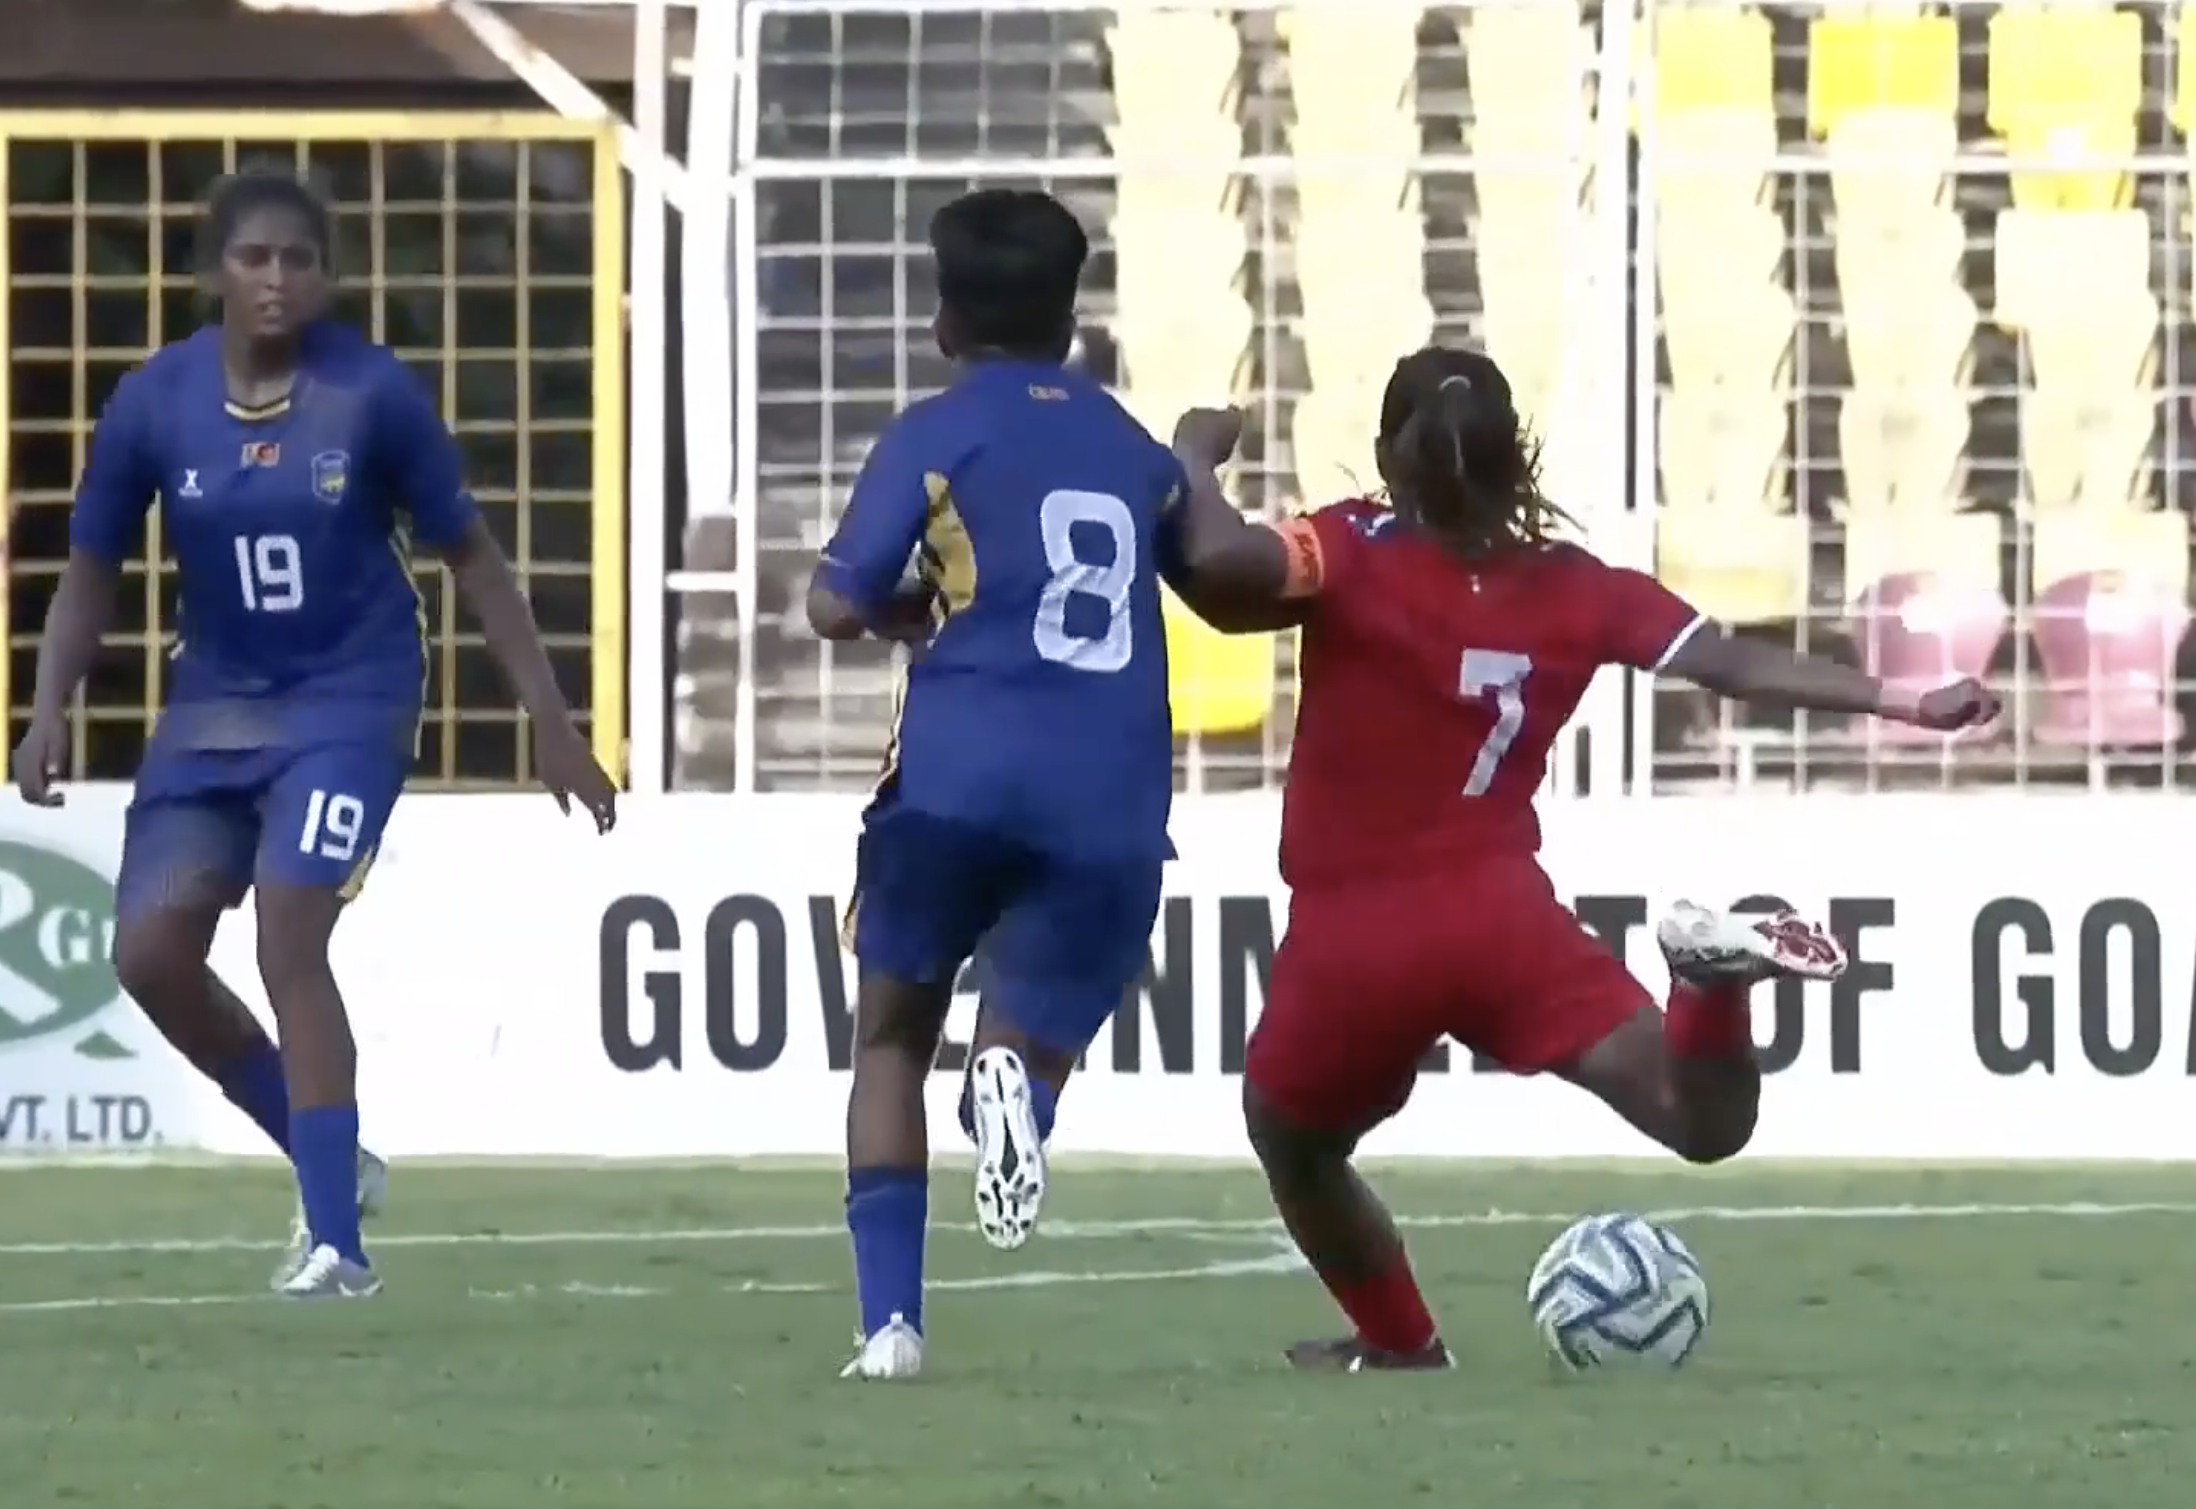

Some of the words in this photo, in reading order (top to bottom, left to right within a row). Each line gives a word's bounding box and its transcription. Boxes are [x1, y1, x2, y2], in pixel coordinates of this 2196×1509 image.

[234, 535, 304, 612] 19
[1033, 489, 1136, 673] 8
[1458, 647, 1532, 796] 7
[299, 789, 364, 860] 19
[1971, 896, 2196, 1076] GO
[66, 1094, 164, 1142] LTD.
